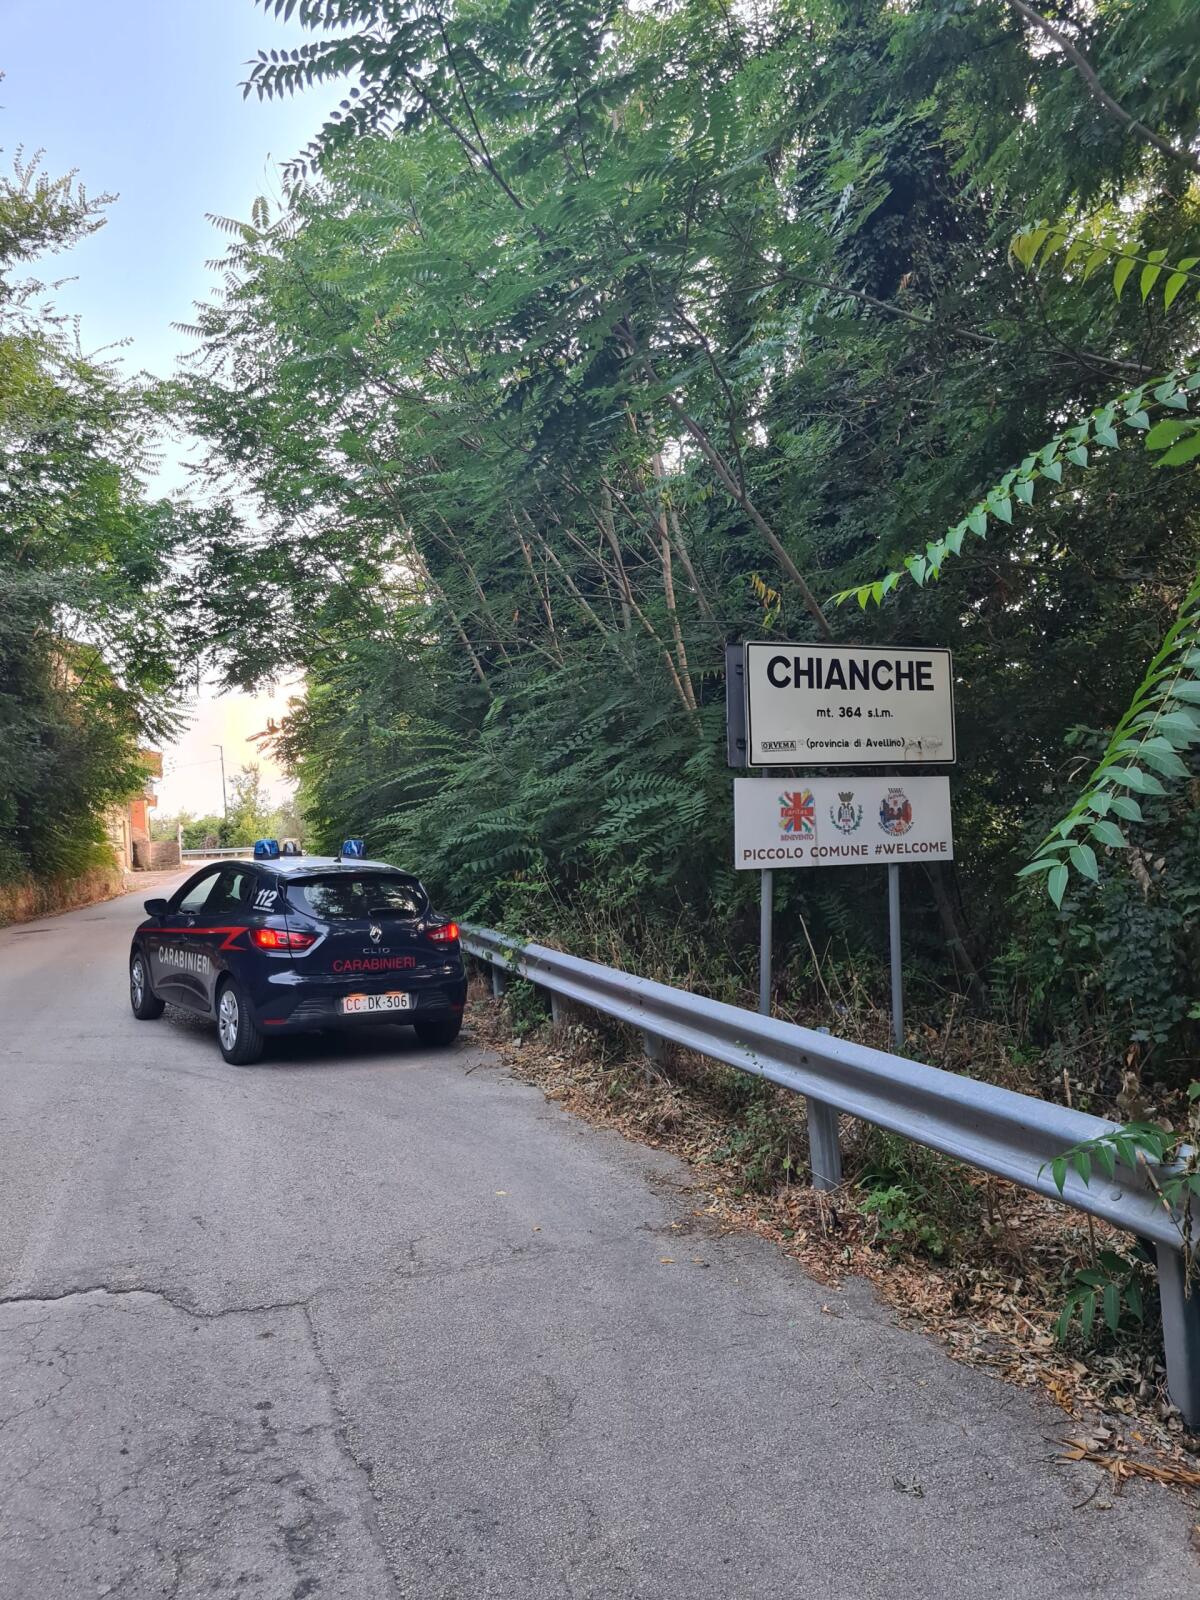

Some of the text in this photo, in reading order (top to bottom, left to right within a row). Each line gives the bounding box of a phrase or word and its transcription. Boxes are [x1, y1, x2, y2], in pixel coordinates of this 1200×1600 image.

[767, 655, 935, 691] CHIANCHE
[816, 707, 894, 718] mt. 364 s.l.m.
[806, 737, 905, 749] (provincia di Avellino)
[743, 842, 947, 860] PICCOLO COMUNE #WELCOME
[254, 888, 278, 907] 112
[158, 945, 210, 975] CARABINIERI
[332, 956, 416, 972] CARABINIERI
[346, 998, 361, 1011] CC
